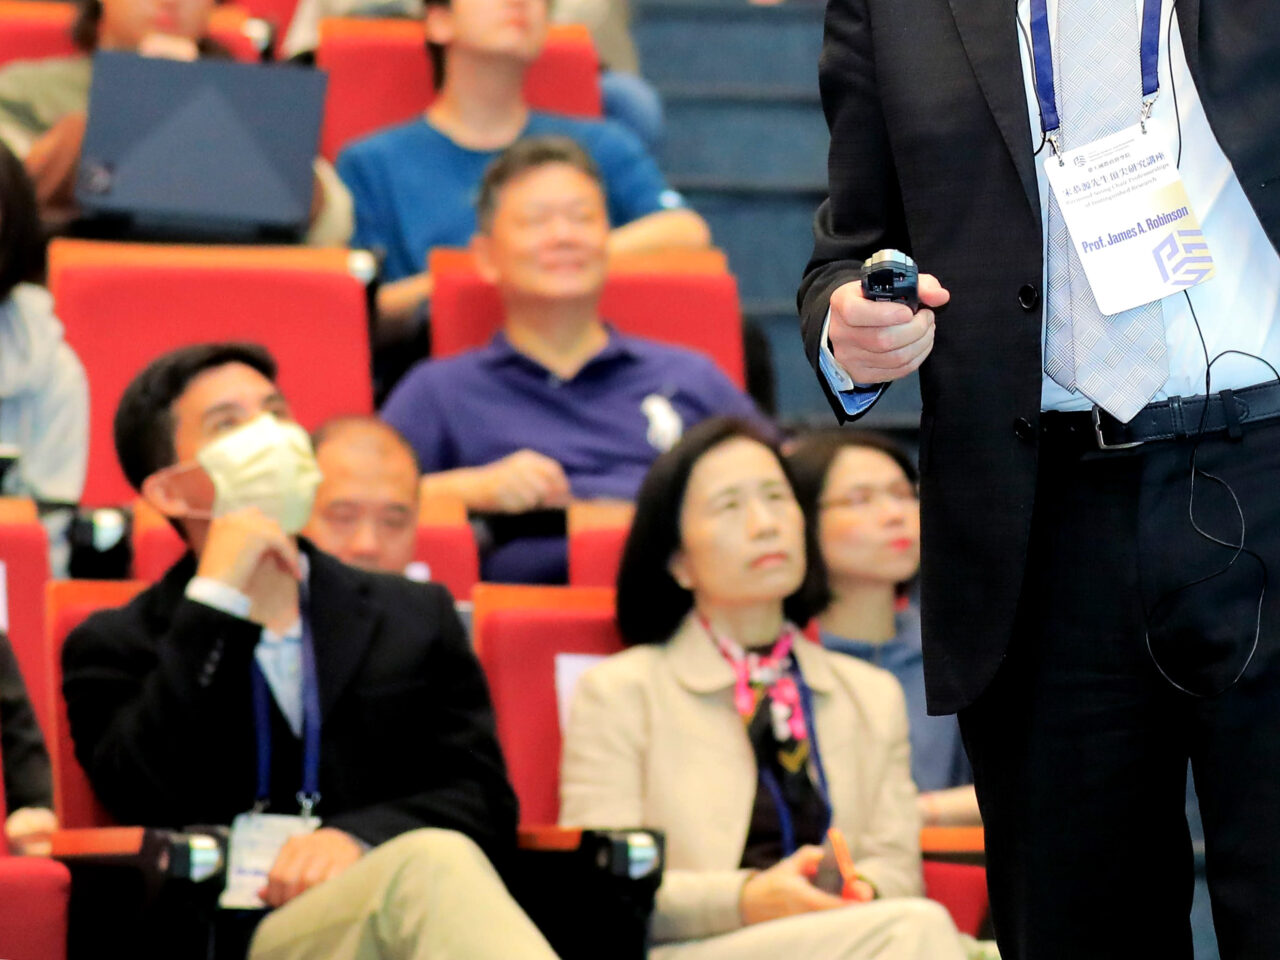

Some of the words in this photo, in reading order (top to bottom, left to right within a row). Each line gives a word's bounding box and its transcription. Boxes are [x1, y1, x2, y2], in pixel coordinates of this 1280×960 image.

[1082, 236, 1107, 253] Prof.
[1107, 227, 1137, 245] James
[1136, 221, 1147, 235] A.
[1146, 206, 1189, 230] Robinson
